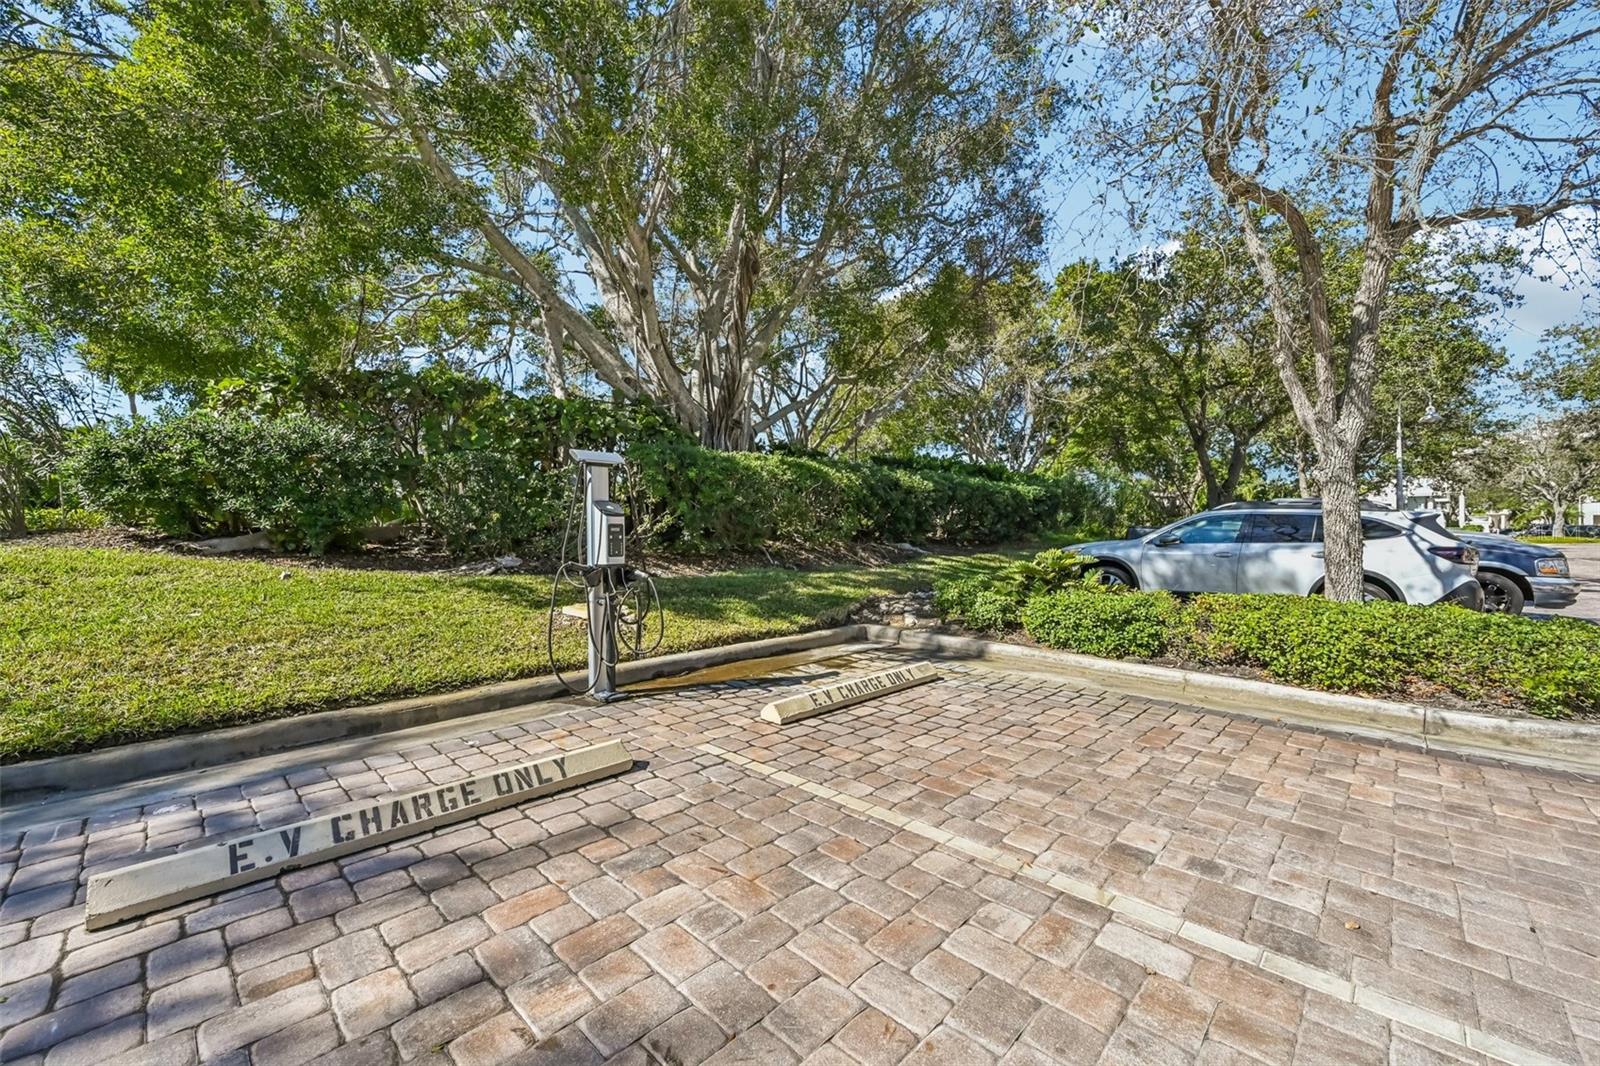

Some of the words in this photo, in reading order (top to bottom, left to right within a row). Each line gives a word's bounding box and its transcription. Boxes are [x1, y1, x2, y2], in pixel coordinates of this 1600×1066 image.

[838, 676, 886, 699] CHARGE
[886, 668, 916, 685] ONLY
[229, 826, 303, 875] E.V
[331, 781, 482, 844] CHARGE
[495, 757, 569, 796] ONLY
